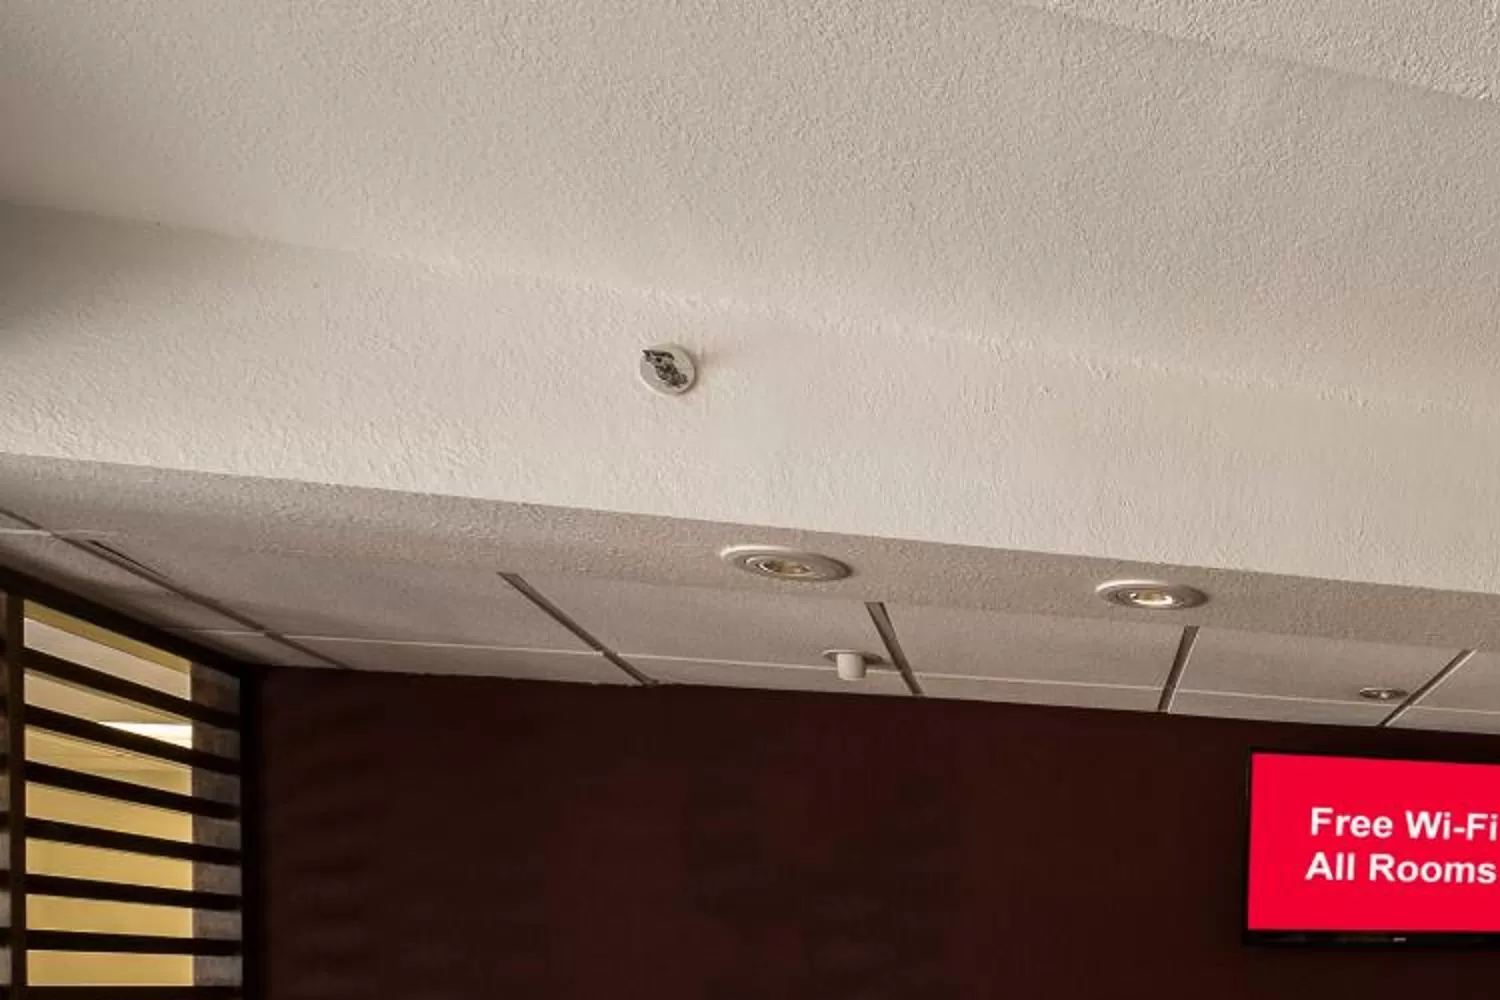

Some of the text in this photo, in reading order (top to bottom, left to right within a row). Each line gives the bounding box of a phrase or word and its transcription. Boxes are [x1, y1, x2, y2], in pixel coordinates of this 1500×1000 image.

[1310, 806, 1498, 841] Free Wi-Fi
[1304, 851, 1498, 884] All Rooms
